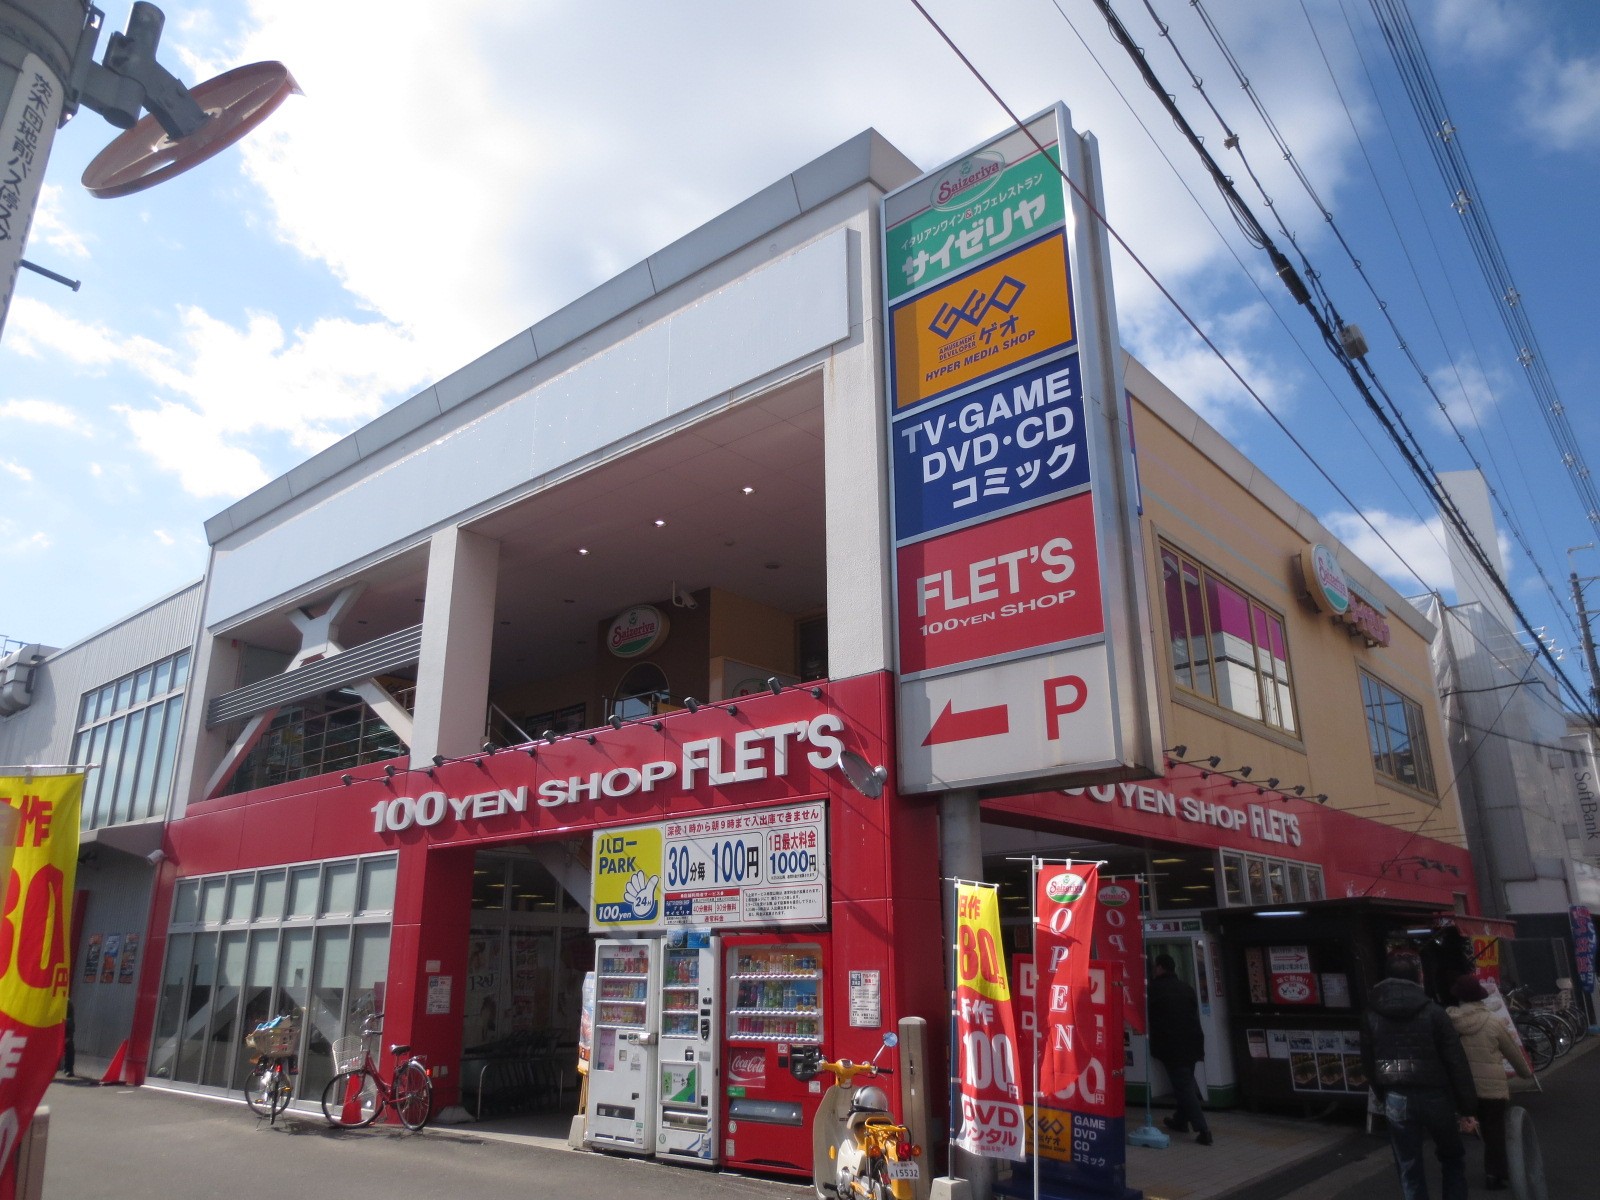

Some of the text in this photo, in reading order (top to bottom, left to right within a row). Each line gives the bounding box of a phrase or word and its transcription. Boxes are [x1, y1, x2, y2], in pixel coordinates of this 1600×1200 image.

[937, 162, 1000, 205] Saizeriya
[902, 194, 1046, 286] サイゼリヤ
[979, 315, 1019, 344] ゲオ
[925, 330, 1036, 382] HYPER MEDIA SHOP
[939, 335, 976, 354] AMUSEMENT
[939, 341, 976, 361] DEVELOPER
[902, 368, 1072, 454] TV-GAME
[952, 443, 1076, 509] コミック
[916, 537, 1076, 617] FLET'S
[999, 590, 1076, 617] SHOP
[611, 620, 655, 648] Saizeriya
[1043, 675, 1088, 741] P
[537, 760, 677, 808] SHOP
[681, 713, 846, 791] FLET'S
[1574, 771, 1600, 841] SoftBank
[1179, 797, 1247, 831] SHOP
[1248, 803, 1301, 847] FLET'S
[599, 837, 638, 855] ハロー
[769, 830, 816, 852] 1日最大料金
[599, 856, 637, 875] PARK
[711, 839, 759, 883] 100円
[769, 850, 817, 875] 1000円
[963, 1100, 1019, 1128] DVD
[1074, 1115, 1106, 1131] GAME
[1074, 1128, 1097, 1141] DVD
[1074, 1140, 1090, 1152] CD
[1074, 1153, 1106, 1168] コミック
